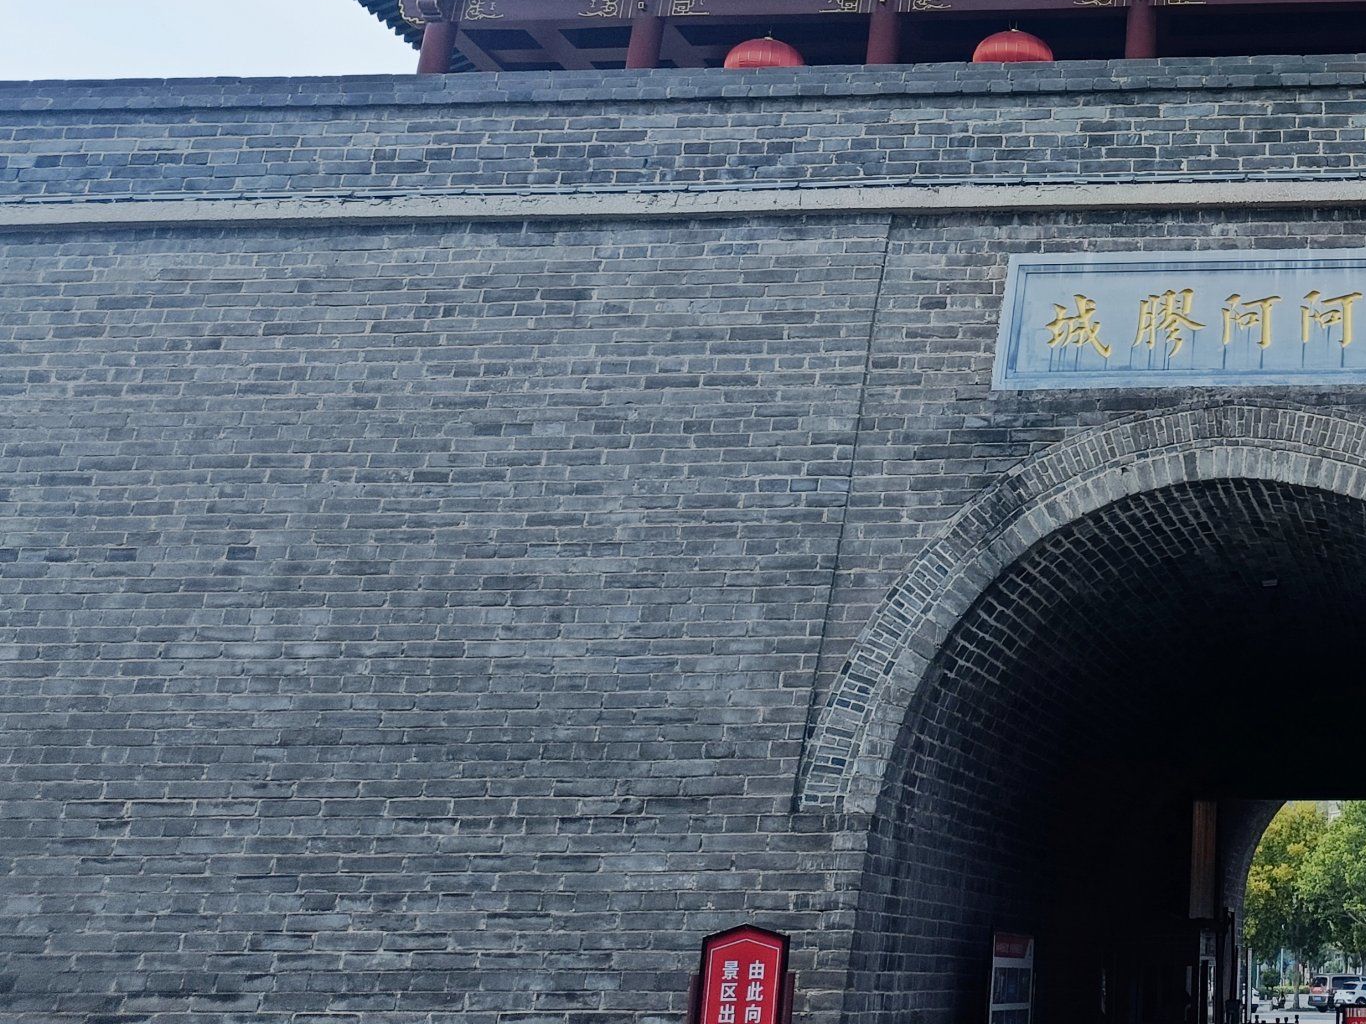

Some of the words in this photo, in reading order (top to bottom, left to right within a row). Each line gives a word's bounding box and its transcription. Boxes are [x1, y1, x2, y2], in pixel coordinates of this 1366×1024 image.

[718, 960, 739, 1024] 景区出
[744, 959, 765, 1024] 由此向
